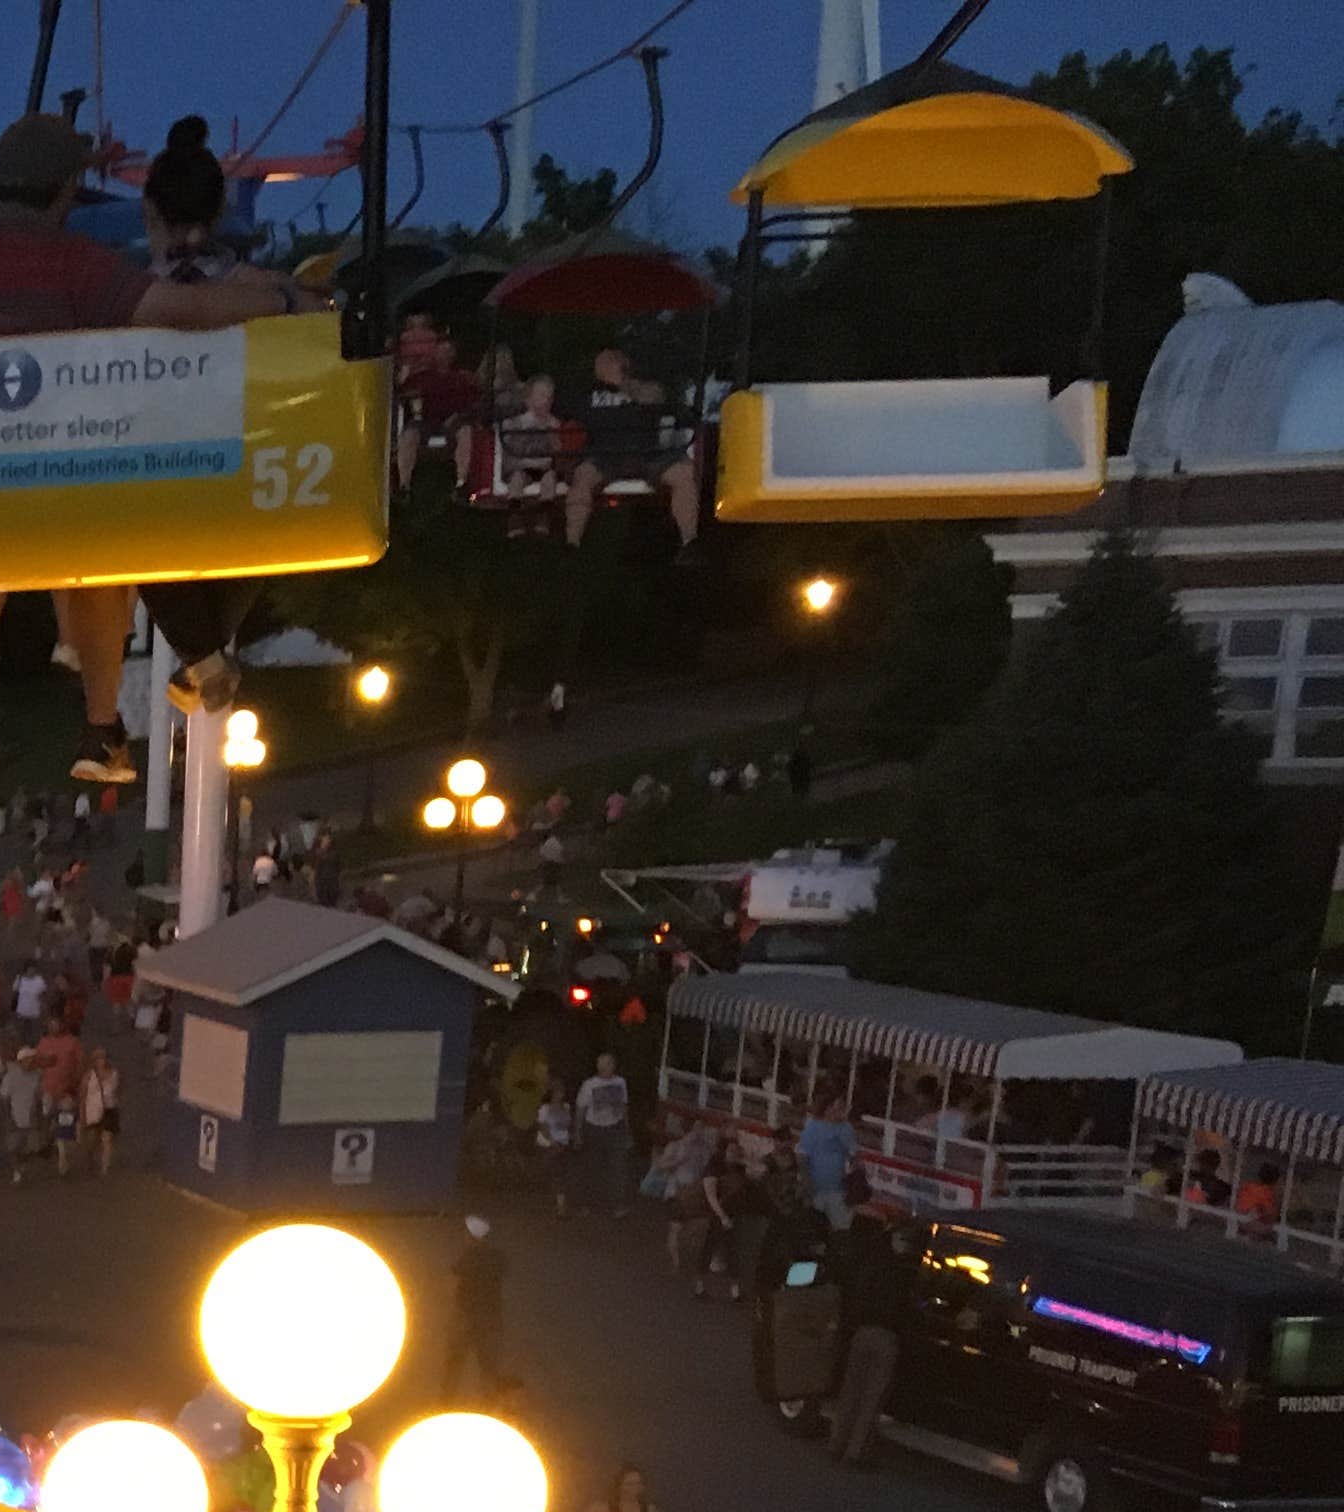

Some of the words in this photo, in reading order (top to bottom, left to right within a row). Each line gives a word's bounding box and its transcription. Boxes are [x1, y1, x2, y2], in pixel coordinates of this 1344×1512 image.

[55, 348, 211, 386] number
[43, 457, 139, 479] Industries
[144, 449, 226, 473] Building
[251, 443, 334, 511] 52
